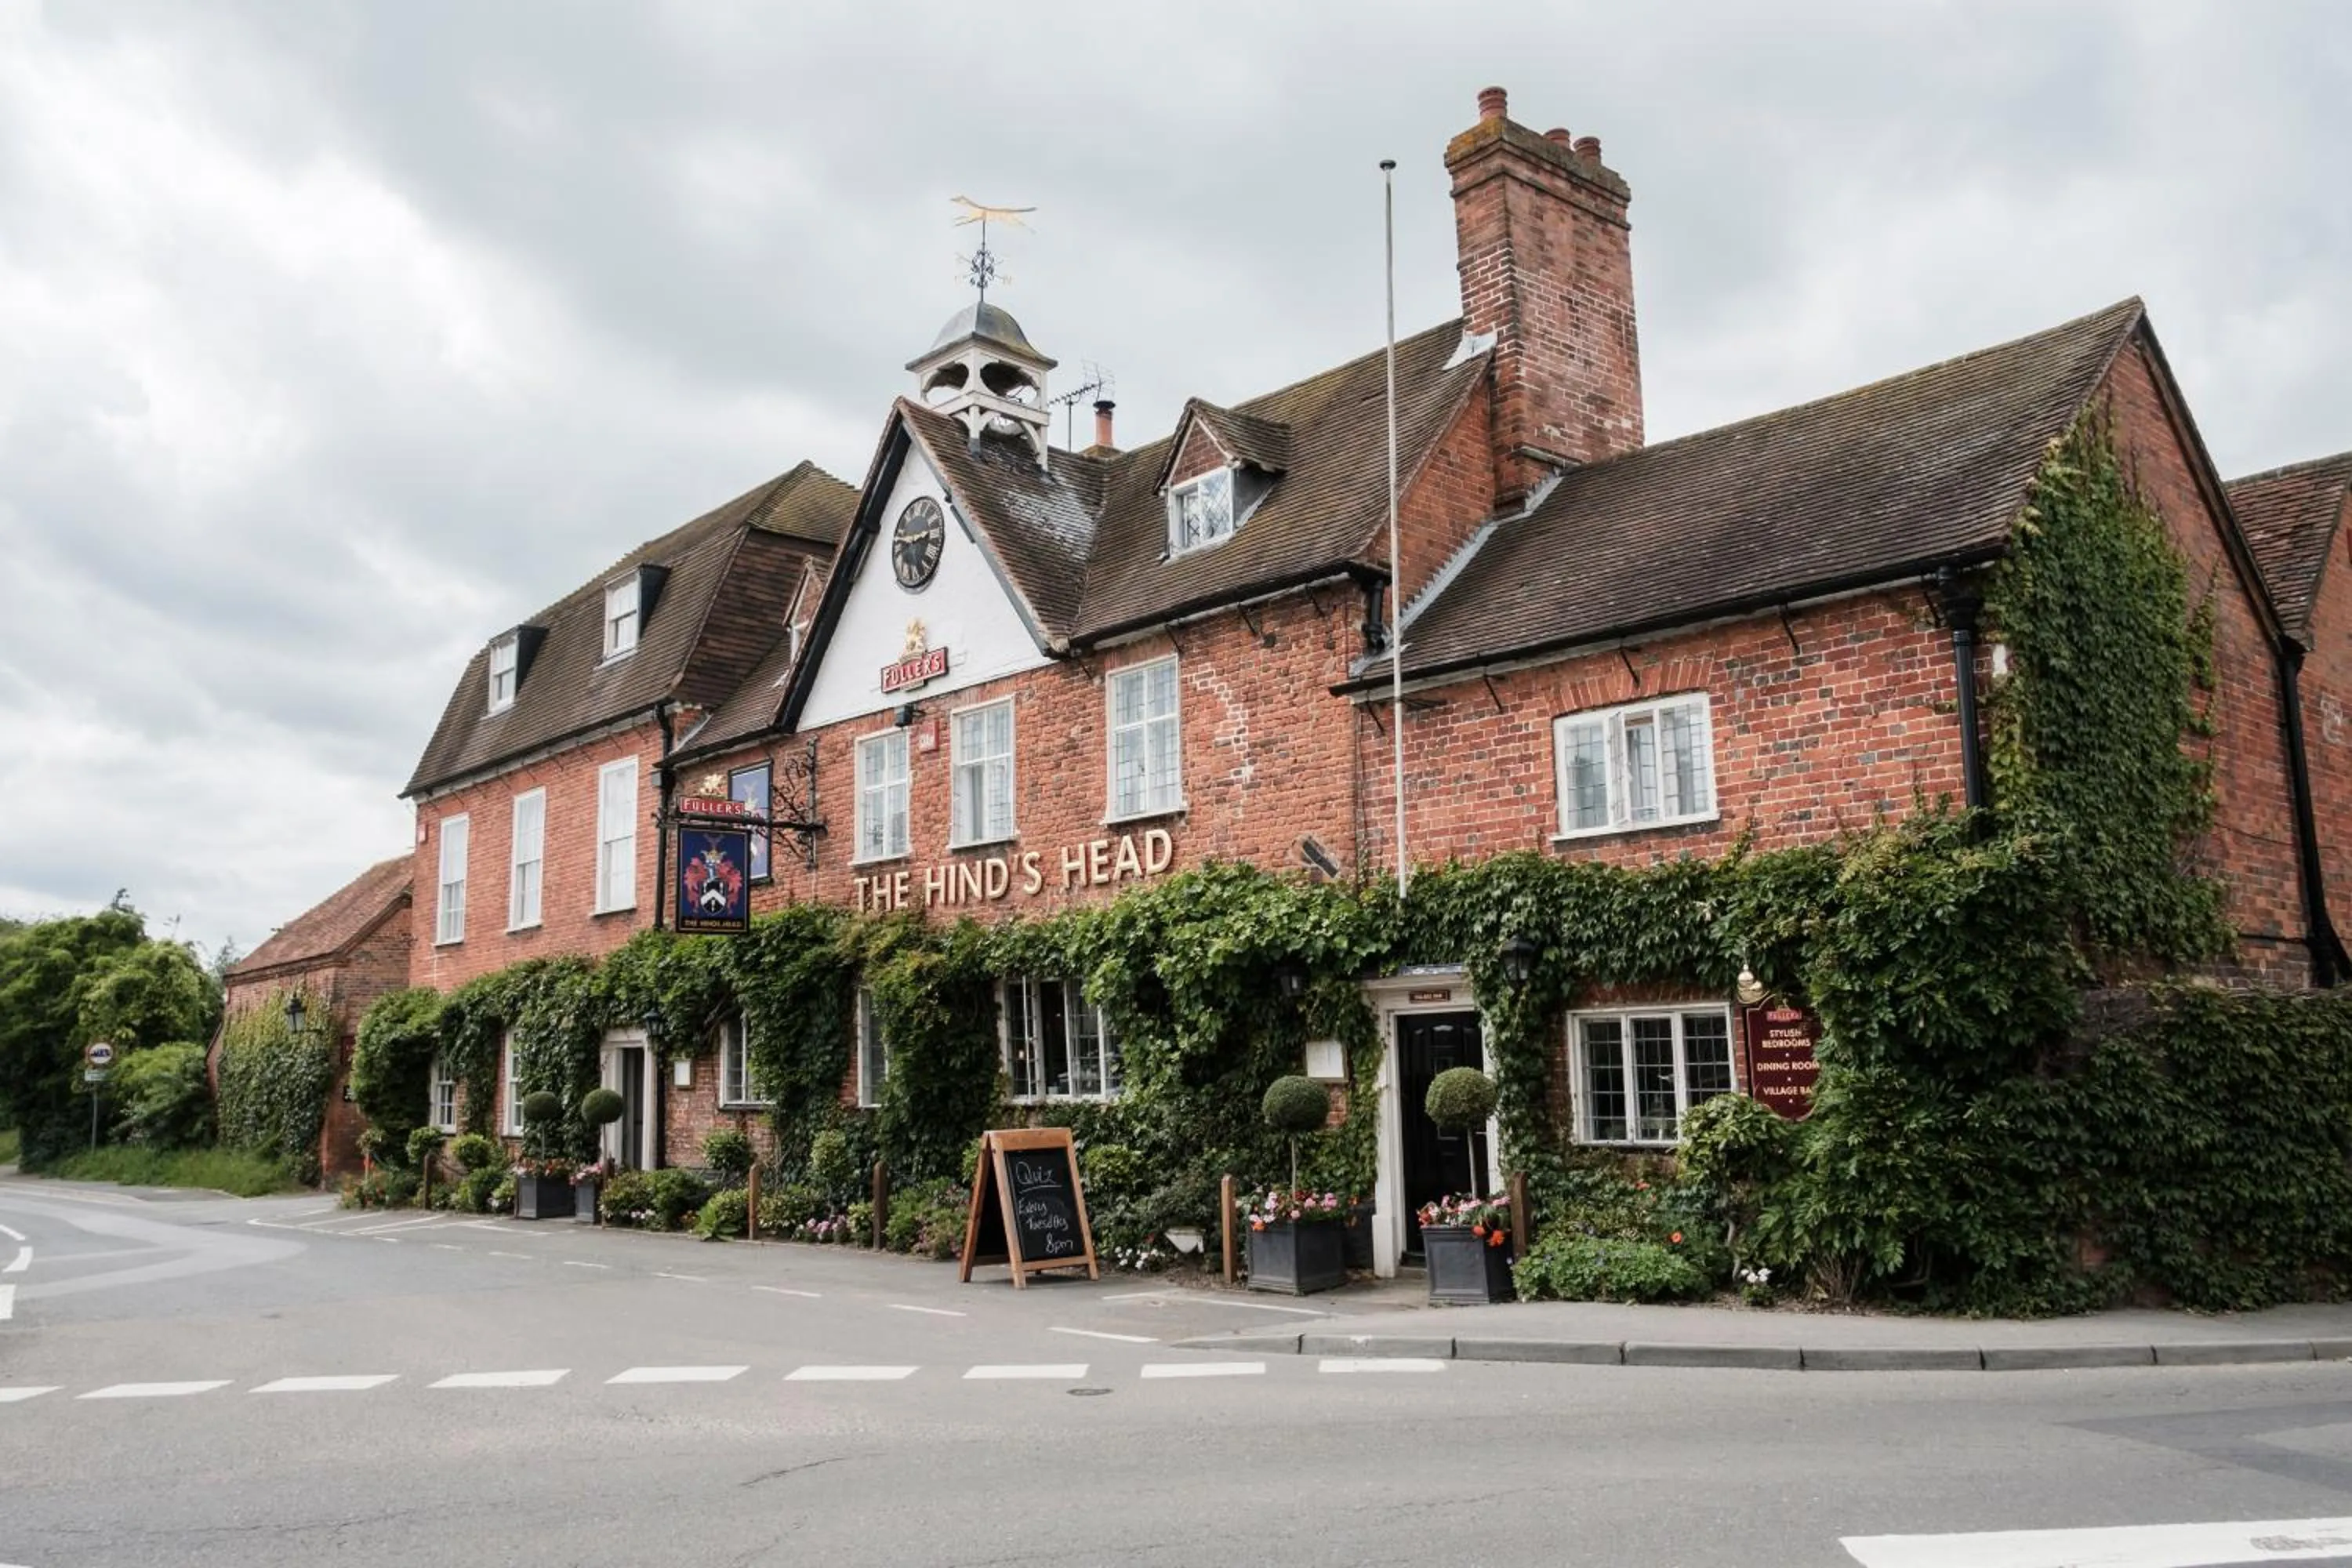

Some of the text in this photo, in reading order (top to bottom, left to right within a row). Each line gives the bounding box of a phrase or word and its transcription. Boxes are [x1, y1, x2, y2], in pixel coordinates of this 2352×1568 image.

[882, 654, 941, 687] FULLER'S
[684, 798, 741, 815] FULLER'S
[855, 829, 1173, 911] THE HIND'S HEAD
[1769, 1029, 1802, 1037] STYLISH
[1762, 1039, 1811, 1048] BEDROOMS
[1757, 1062, 1790, 1071] DINING
[1763, 1087, 1813, 1095] VILLAGE BA
[1016, 1161, 1056, 1185] Quiz
[1018, 1197, 1048, 1217] Every
[1046, 1232, 1073, 1254] 8pm
